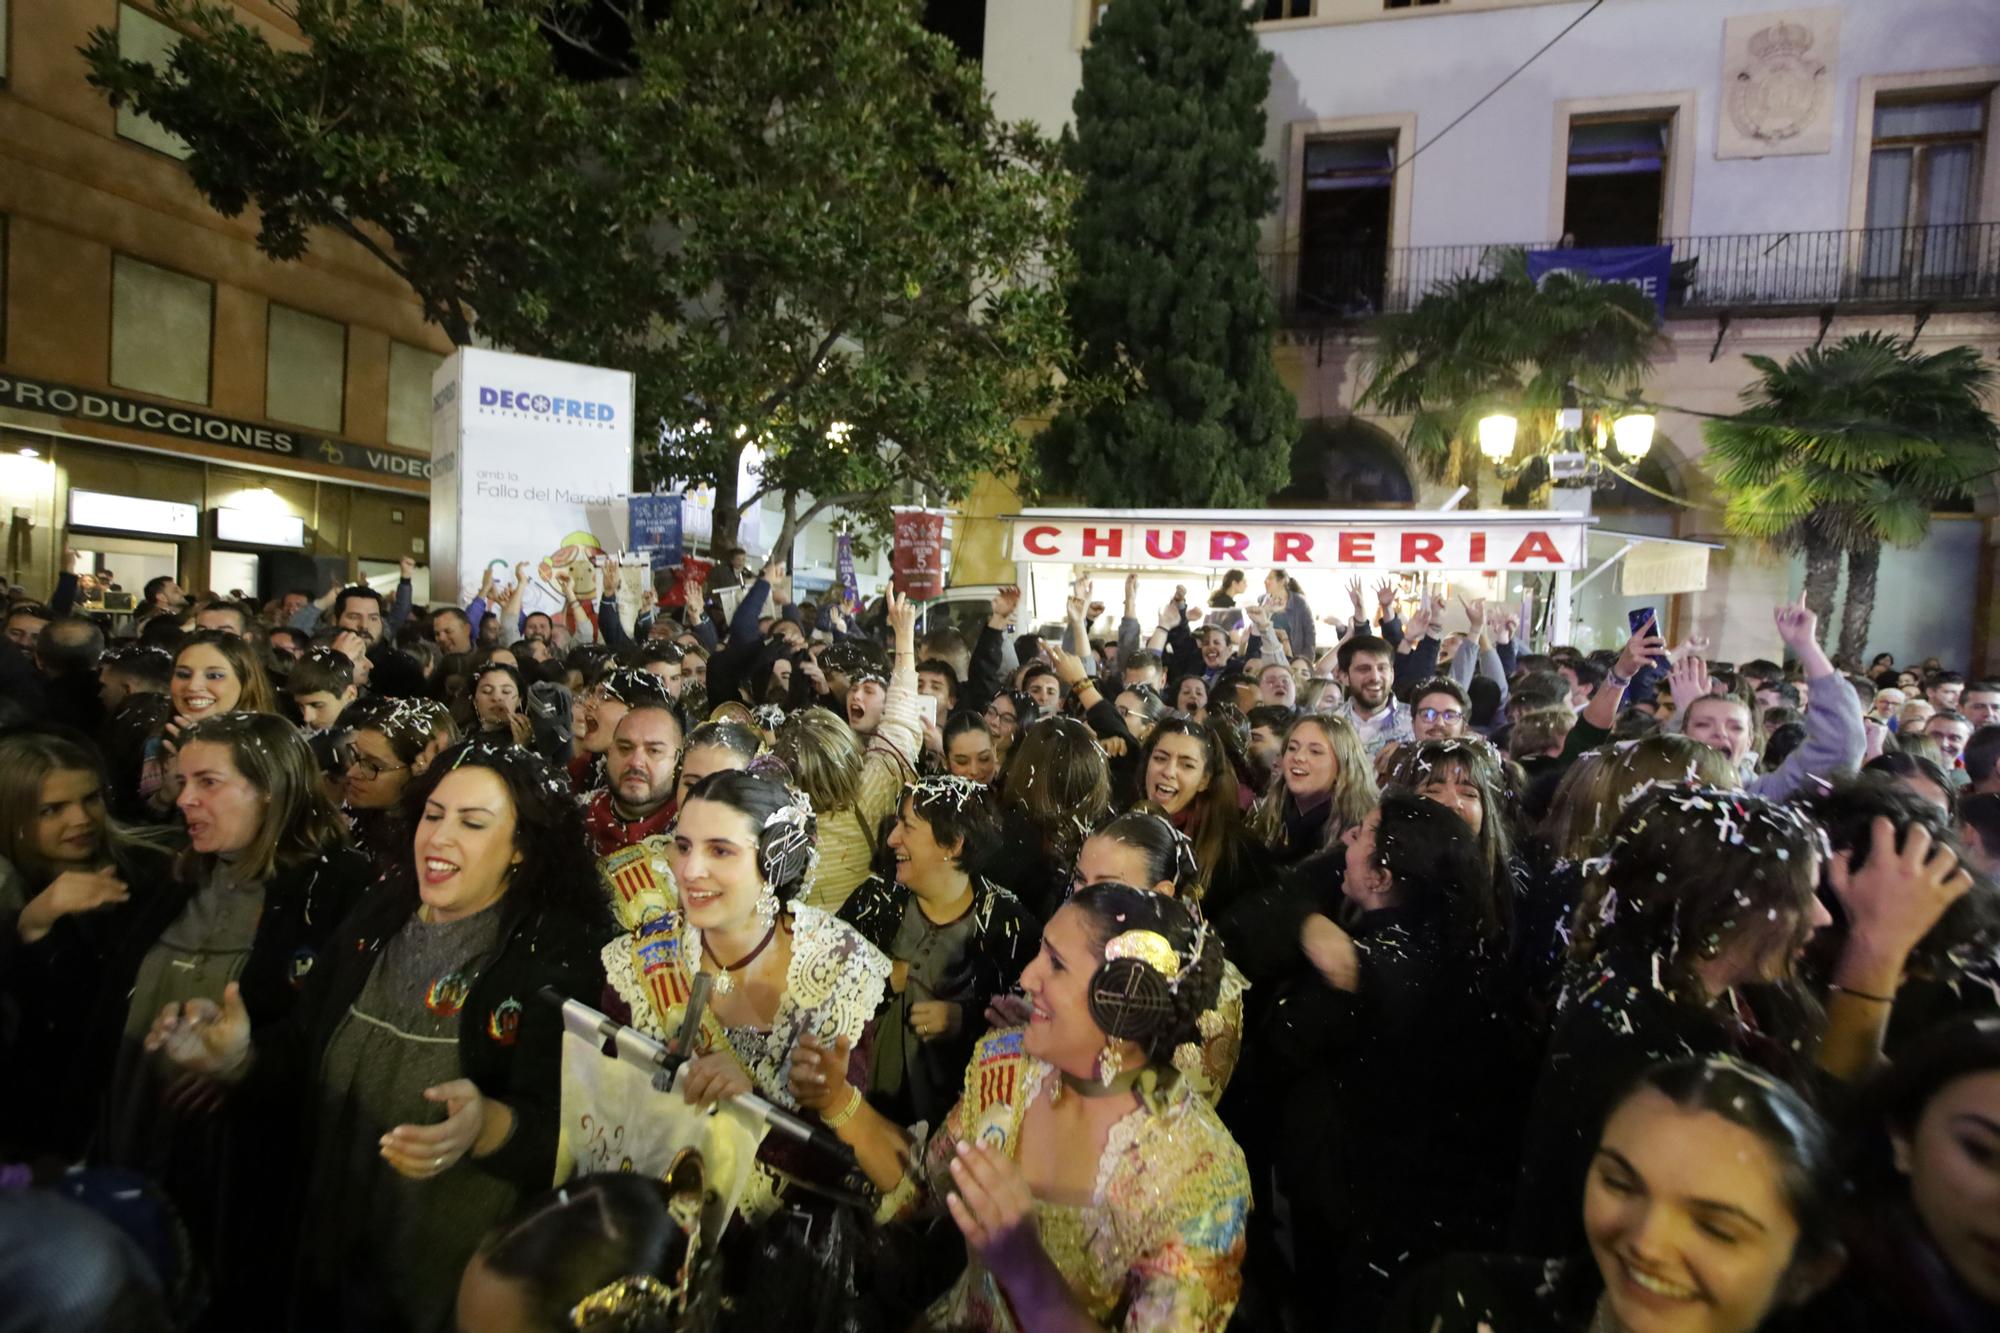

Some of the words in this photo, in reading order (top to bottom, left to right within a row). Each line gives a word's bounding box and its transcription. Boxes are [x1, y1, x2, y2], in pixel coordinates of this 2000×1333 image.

[480, 387, 615, 422] DECOFRED
[476, 470, 505, 481] amb
[507, 471, 519, 481] la
[477, 481, 519, 499] Falla
[523, 486, 550, 502] del
[555, 488, 612, 506] Mercat
[1023, 526, 1564, 563] CHURRERIA
